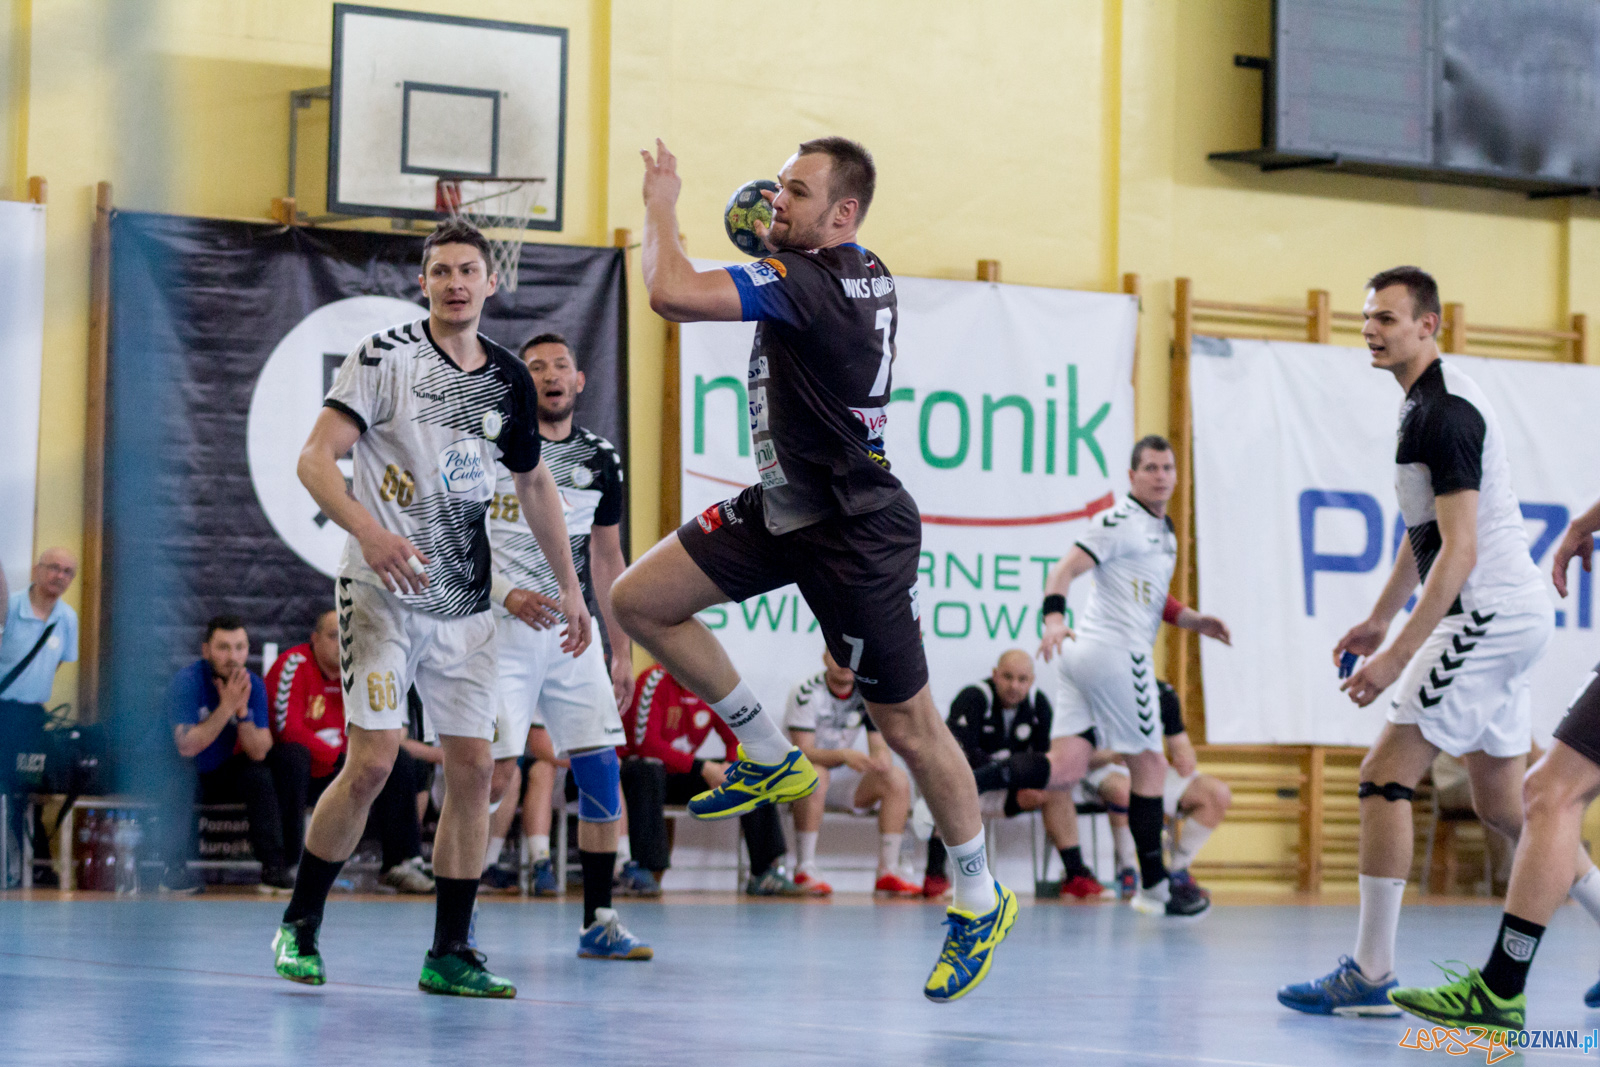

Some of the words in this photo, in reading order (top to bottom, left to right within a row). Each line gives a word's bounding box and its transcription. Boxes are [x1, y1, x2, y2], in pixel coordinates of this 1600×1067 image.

[841, 278, 871, 299] WKS
[869, 307, 892, 397] 7
[380, 464, 416, 508] 66
[449, 466, 485, 481] Cukie
[842, 633, 864, 672] 7
[367, 671, 398, 713] 66
